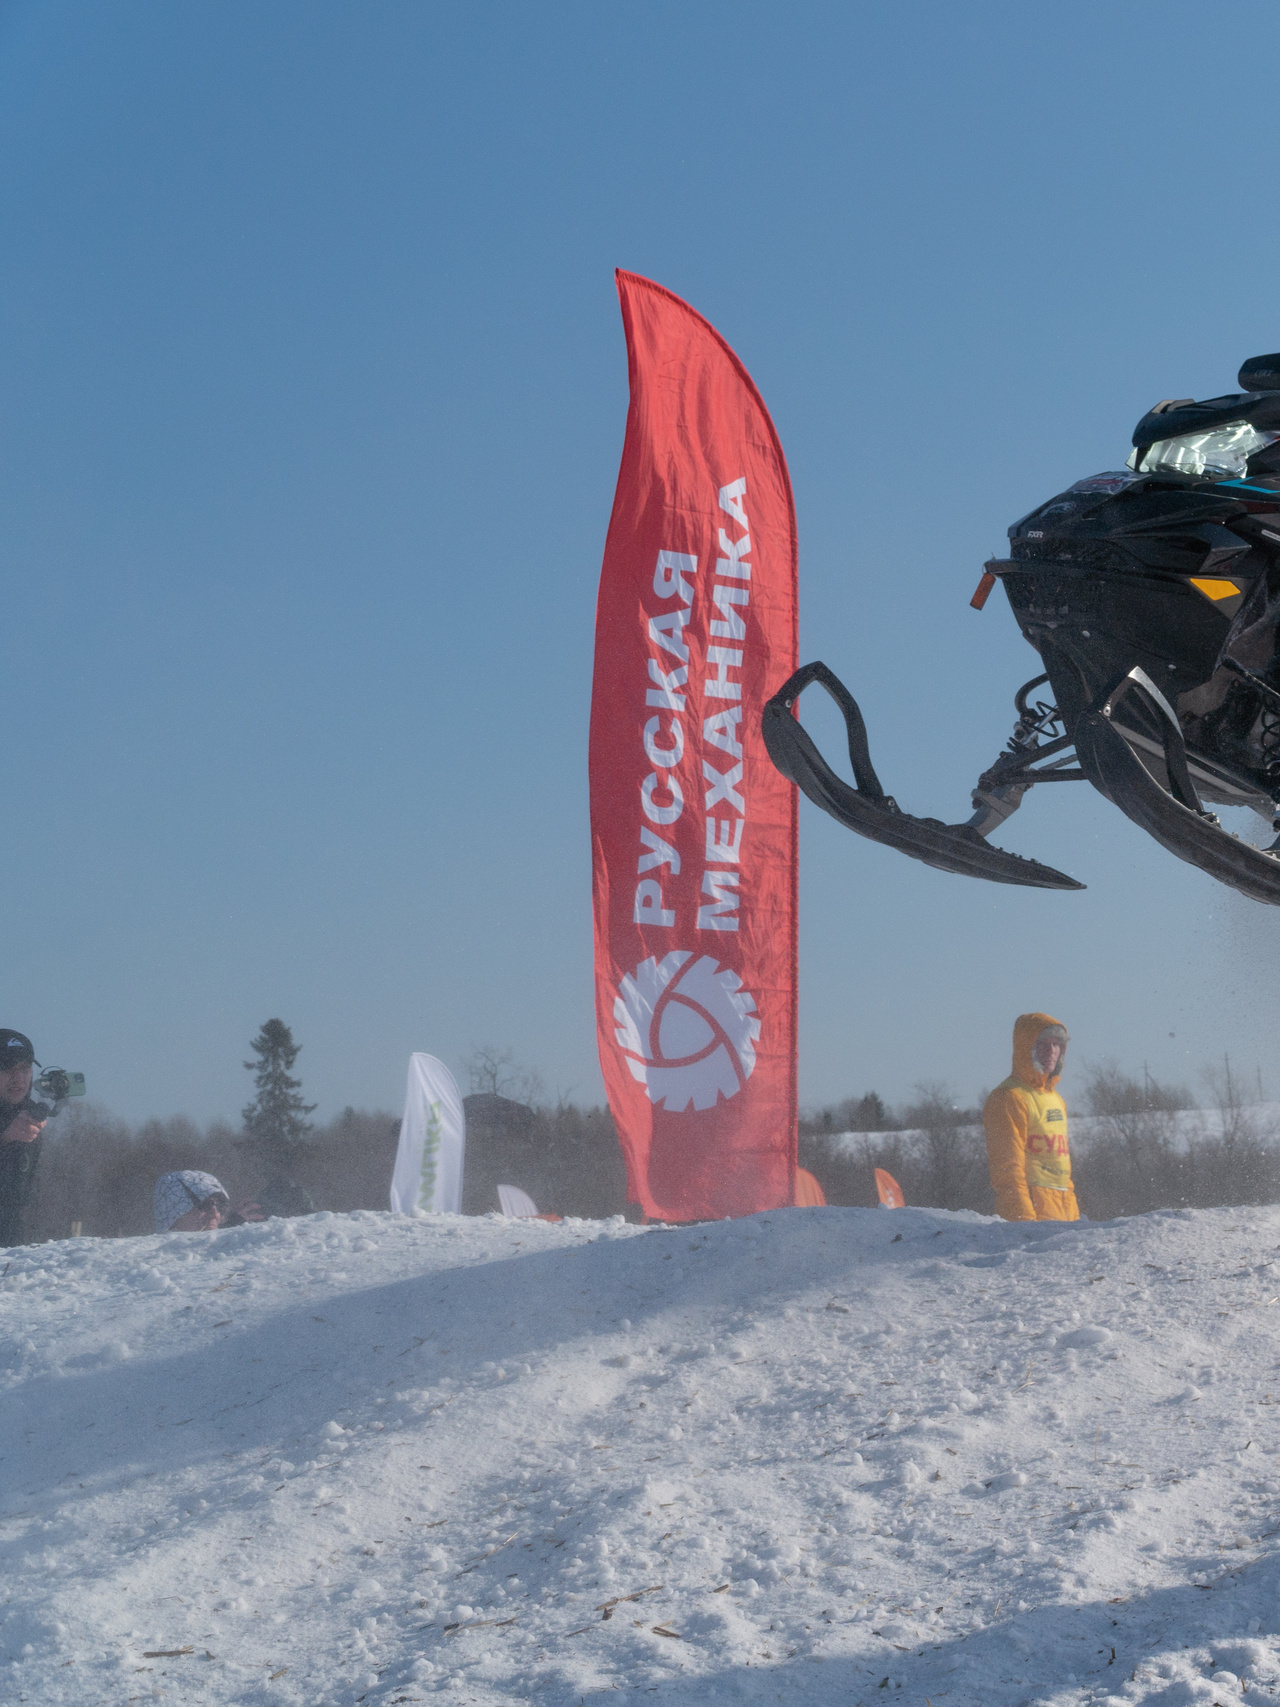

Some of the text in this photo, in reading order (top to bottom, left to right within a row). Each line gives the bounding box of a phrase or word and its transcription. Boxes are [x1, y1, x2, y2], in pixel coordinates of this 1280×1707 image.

[696, 476, 752, 932] МЕХАНИКА
[1027, 530, 1044, 538] FXR
[633, 549, 699, 928] РУССКАЯ
